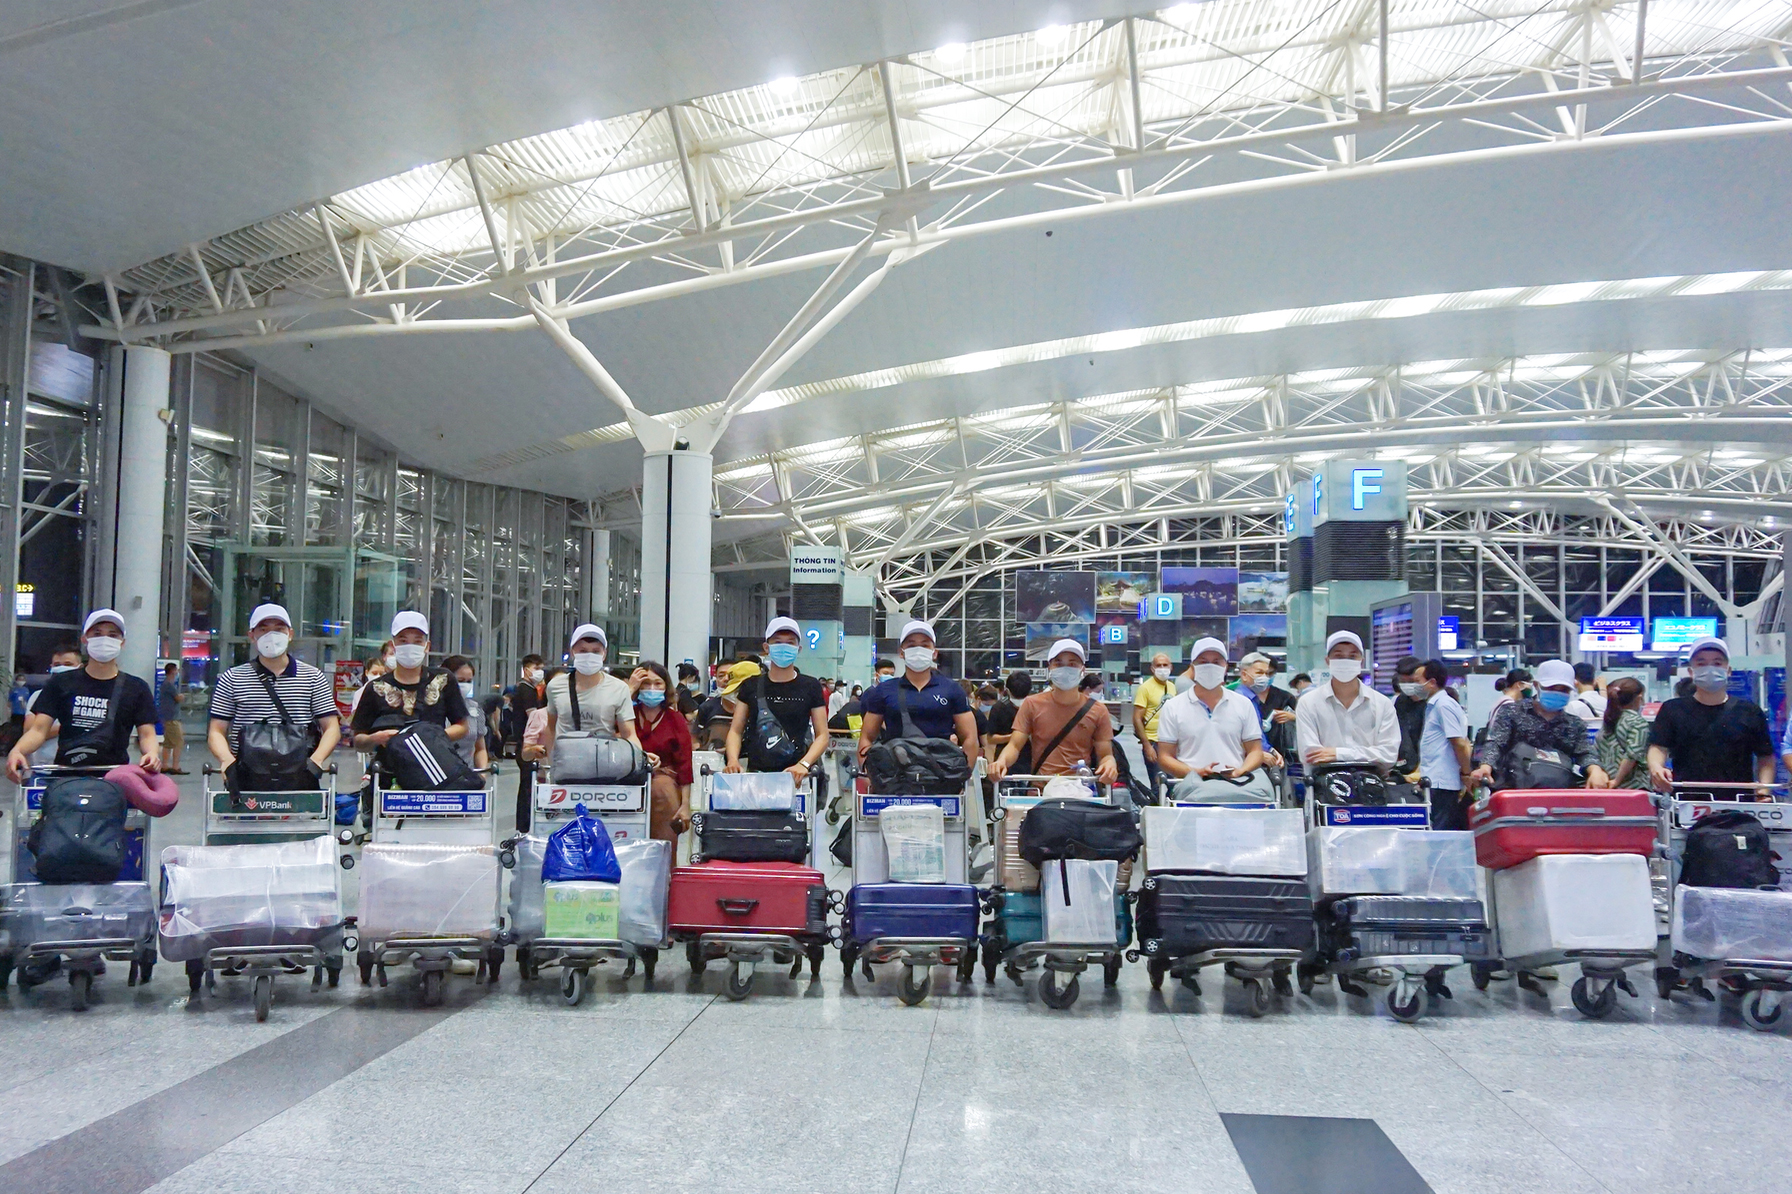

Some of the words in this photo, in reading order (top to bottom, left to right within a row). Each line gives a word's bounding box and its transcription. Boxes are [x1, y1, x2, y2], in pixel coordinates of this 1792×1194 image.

[1313, 474, 1322, 515] F
[1353, 468, 1384, 510] F
[1157, 596, 1174, 616] D
[1110, 627, 1123, 641] B
[74, 695, 109, 709] SHOCK
[80, 706, 107, 718] GAME
[570, 792, 628, 803] DORCO
[260, 801, 292, 809] VPBank
